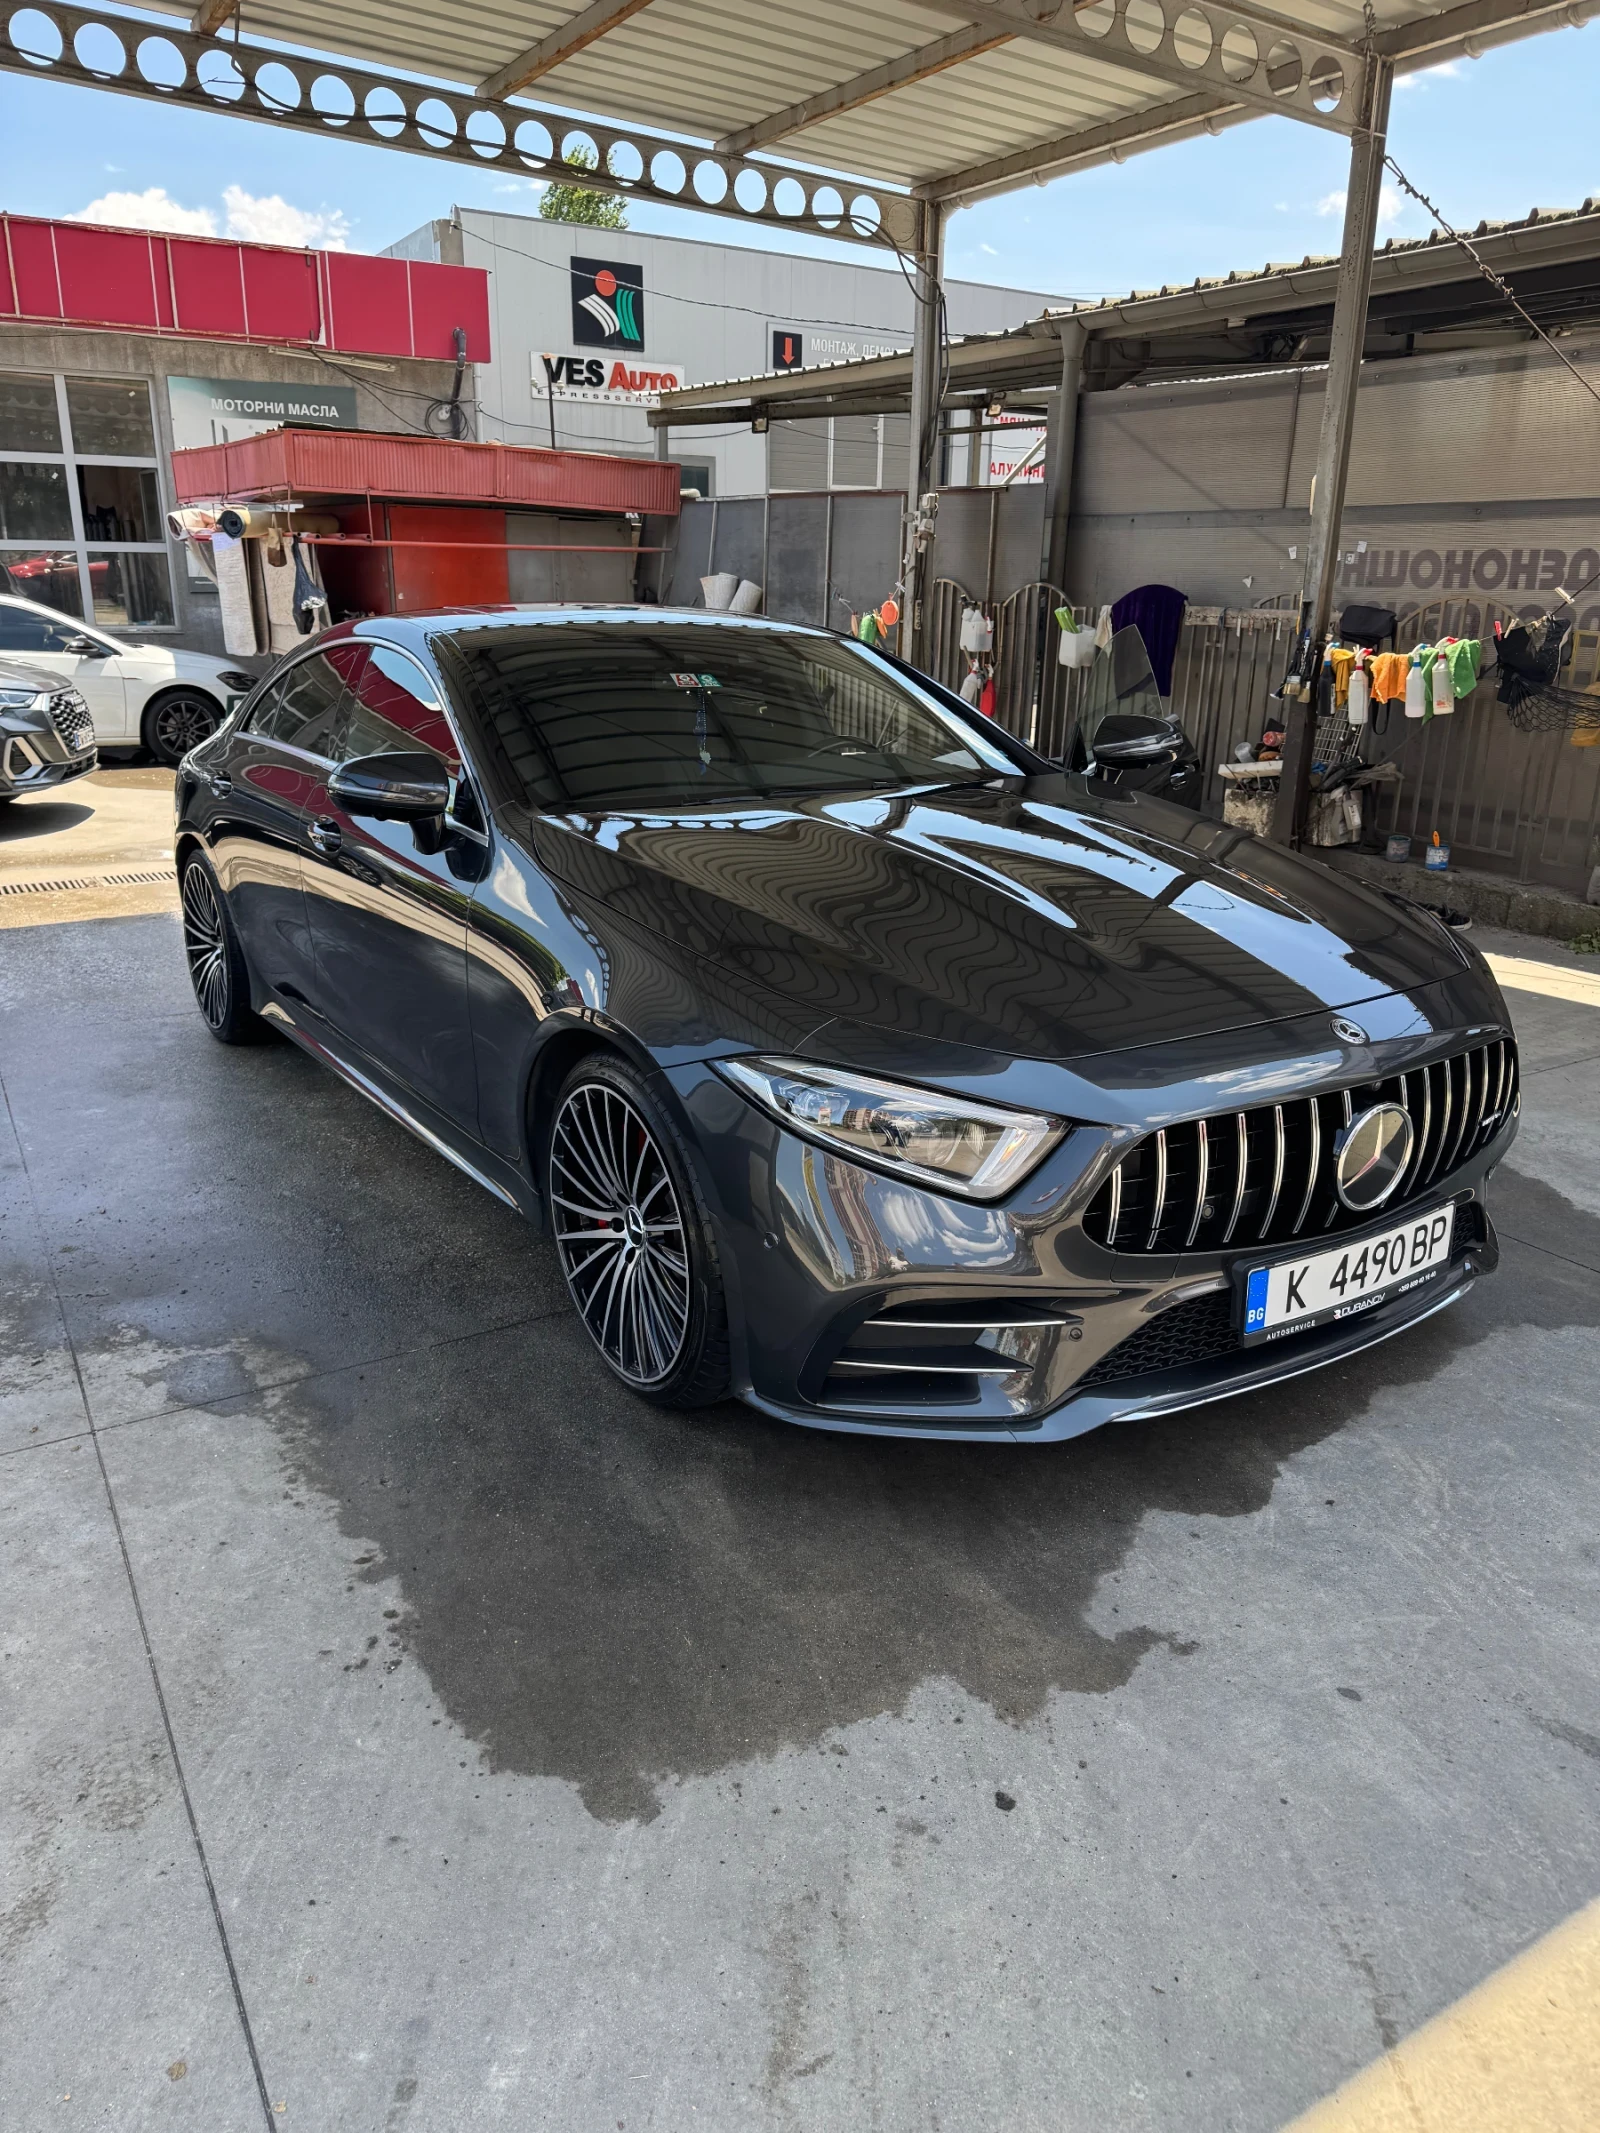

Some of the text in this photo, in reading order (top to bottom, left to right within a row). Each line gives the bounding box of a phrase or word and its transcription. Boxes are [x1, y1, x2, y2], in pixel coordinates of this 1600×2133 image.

[811, 338, 860, 357] МОНТАЖ,
[541, 353, 678, 391] VES AUTO
[211, 398, 340, 418] МОТОРНИ МАСЛА
[1285, 1215, 1447, 1313] K 4490 BP
[1247, 1308, 1265, 1324] BG
[1266, 1320, 1316, 1341] AUTOSERVICE
